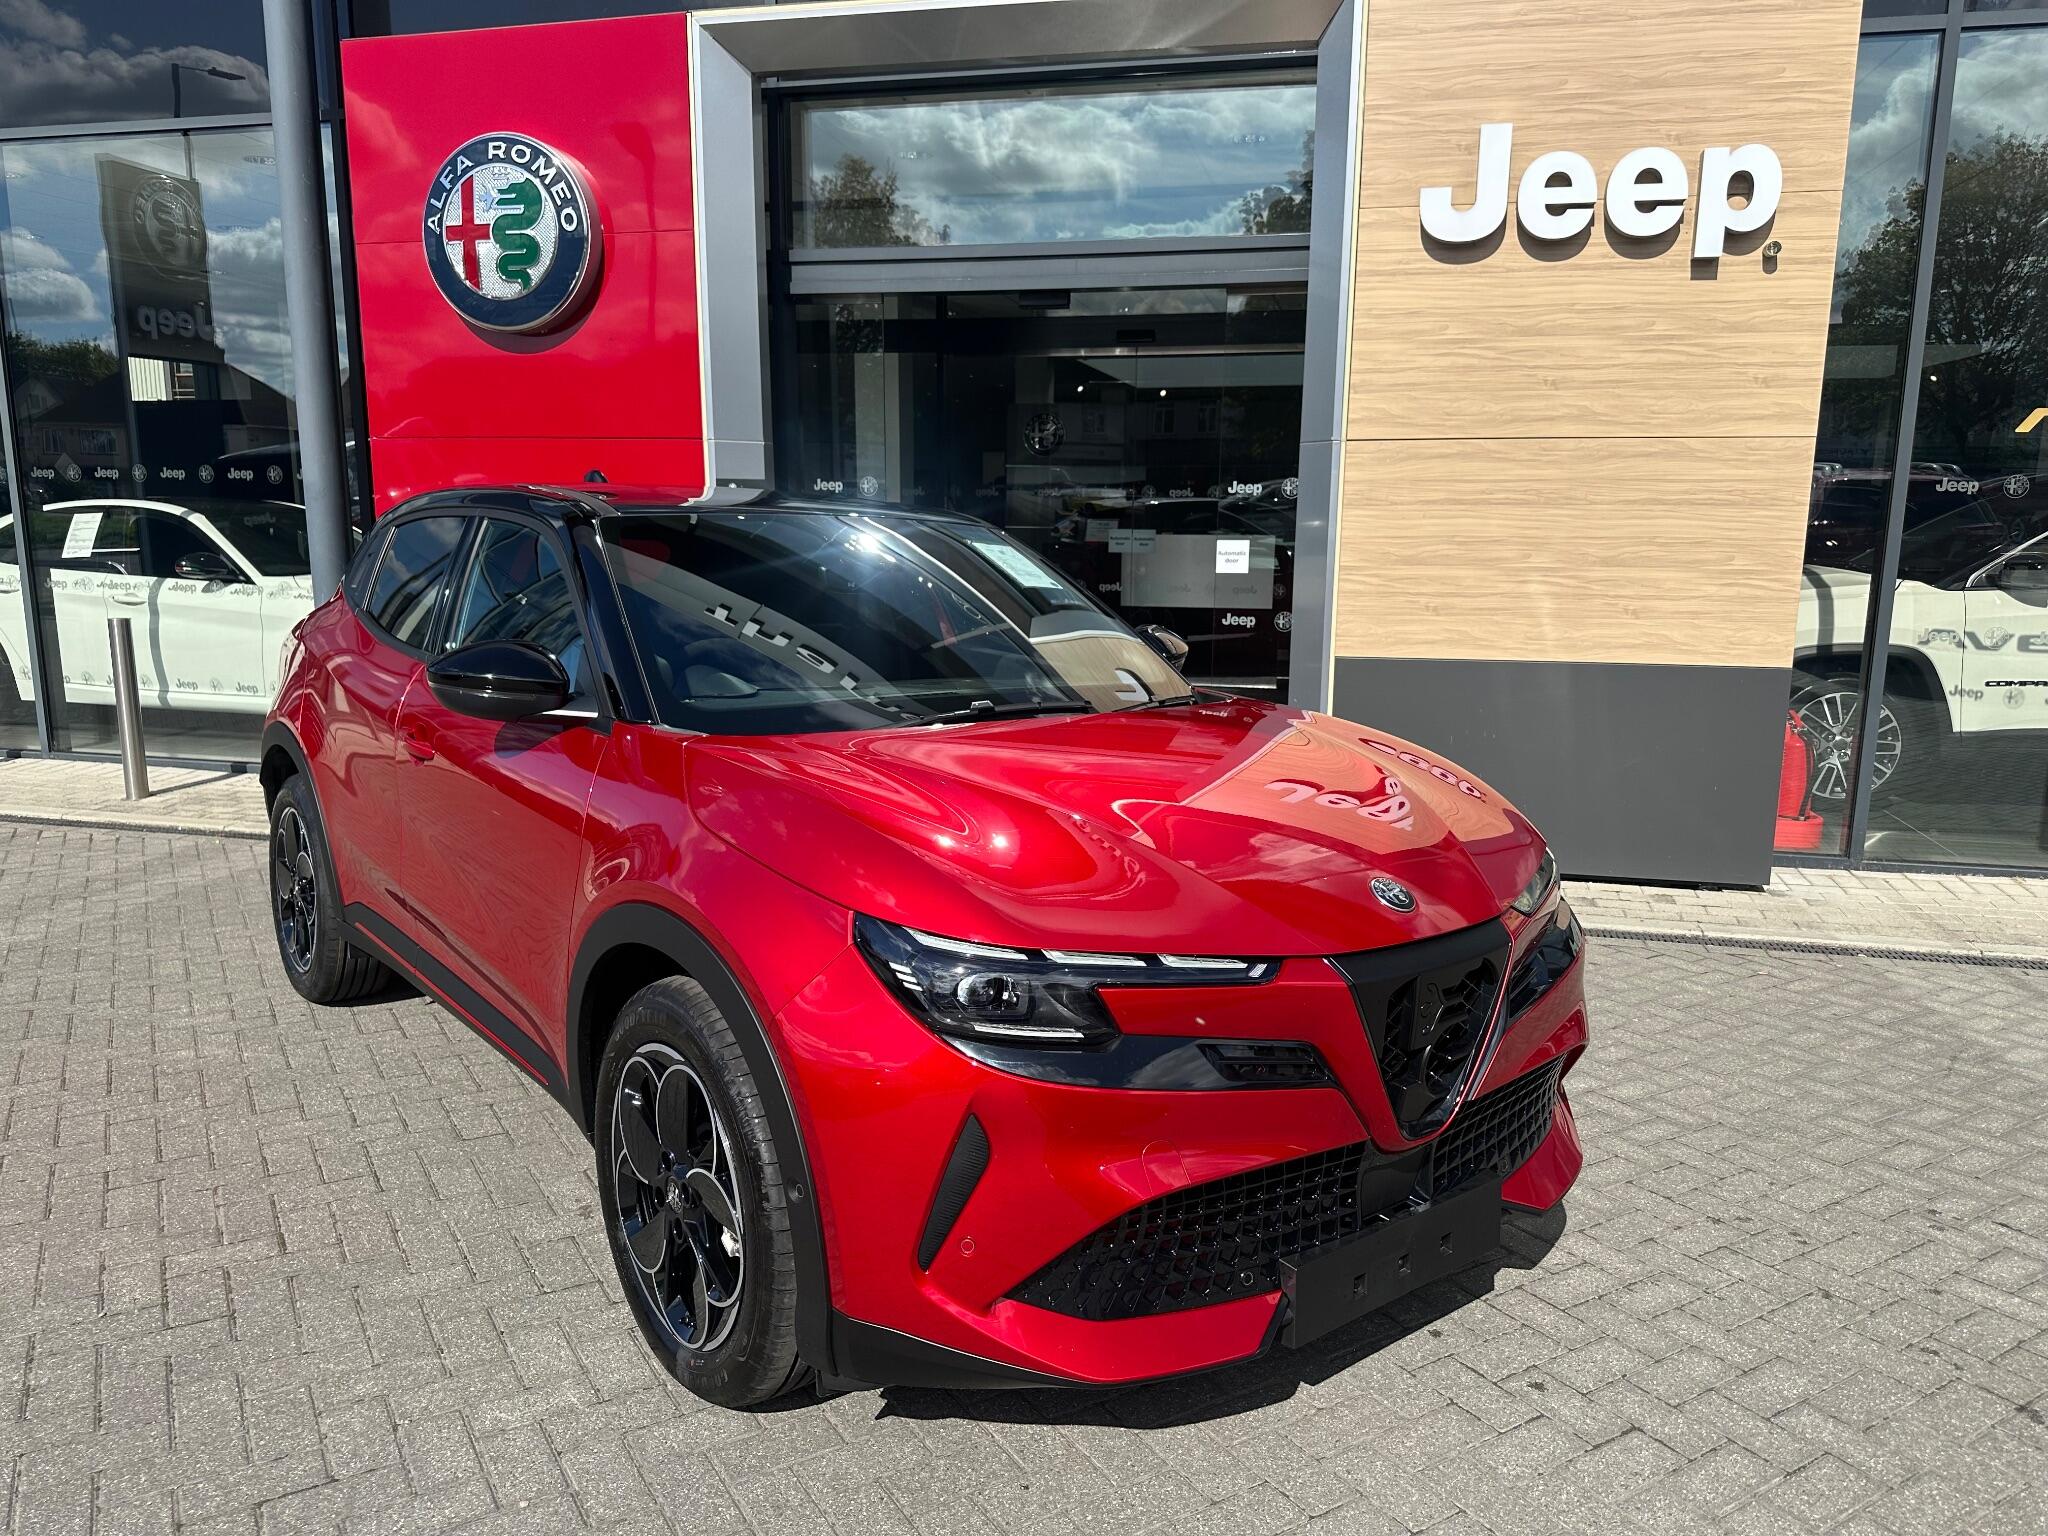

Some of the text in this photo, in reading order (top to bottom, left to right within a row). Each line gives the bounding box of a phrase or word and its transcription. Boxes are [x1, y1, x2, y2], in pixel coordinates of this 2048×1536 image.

[427, 141, 578, 235] ALFA ROMEO
[1418, 123, 1783, 260] Jeep
[31, 466, 55, 480] Jeep
[94, 466, 119, 480] Jeep
[160, 466, 186, 481] Jeep
[227, 467, 254, 481] Jeep
[814, 478, 844, 493] Jeep
[1227, 480, 1263, 496] Jeep
[1936, 477, 1979, 495] Jeep
[1221, 612, 1256, 629] Jeep
[1949, 684, 1984, 701] Jeep
